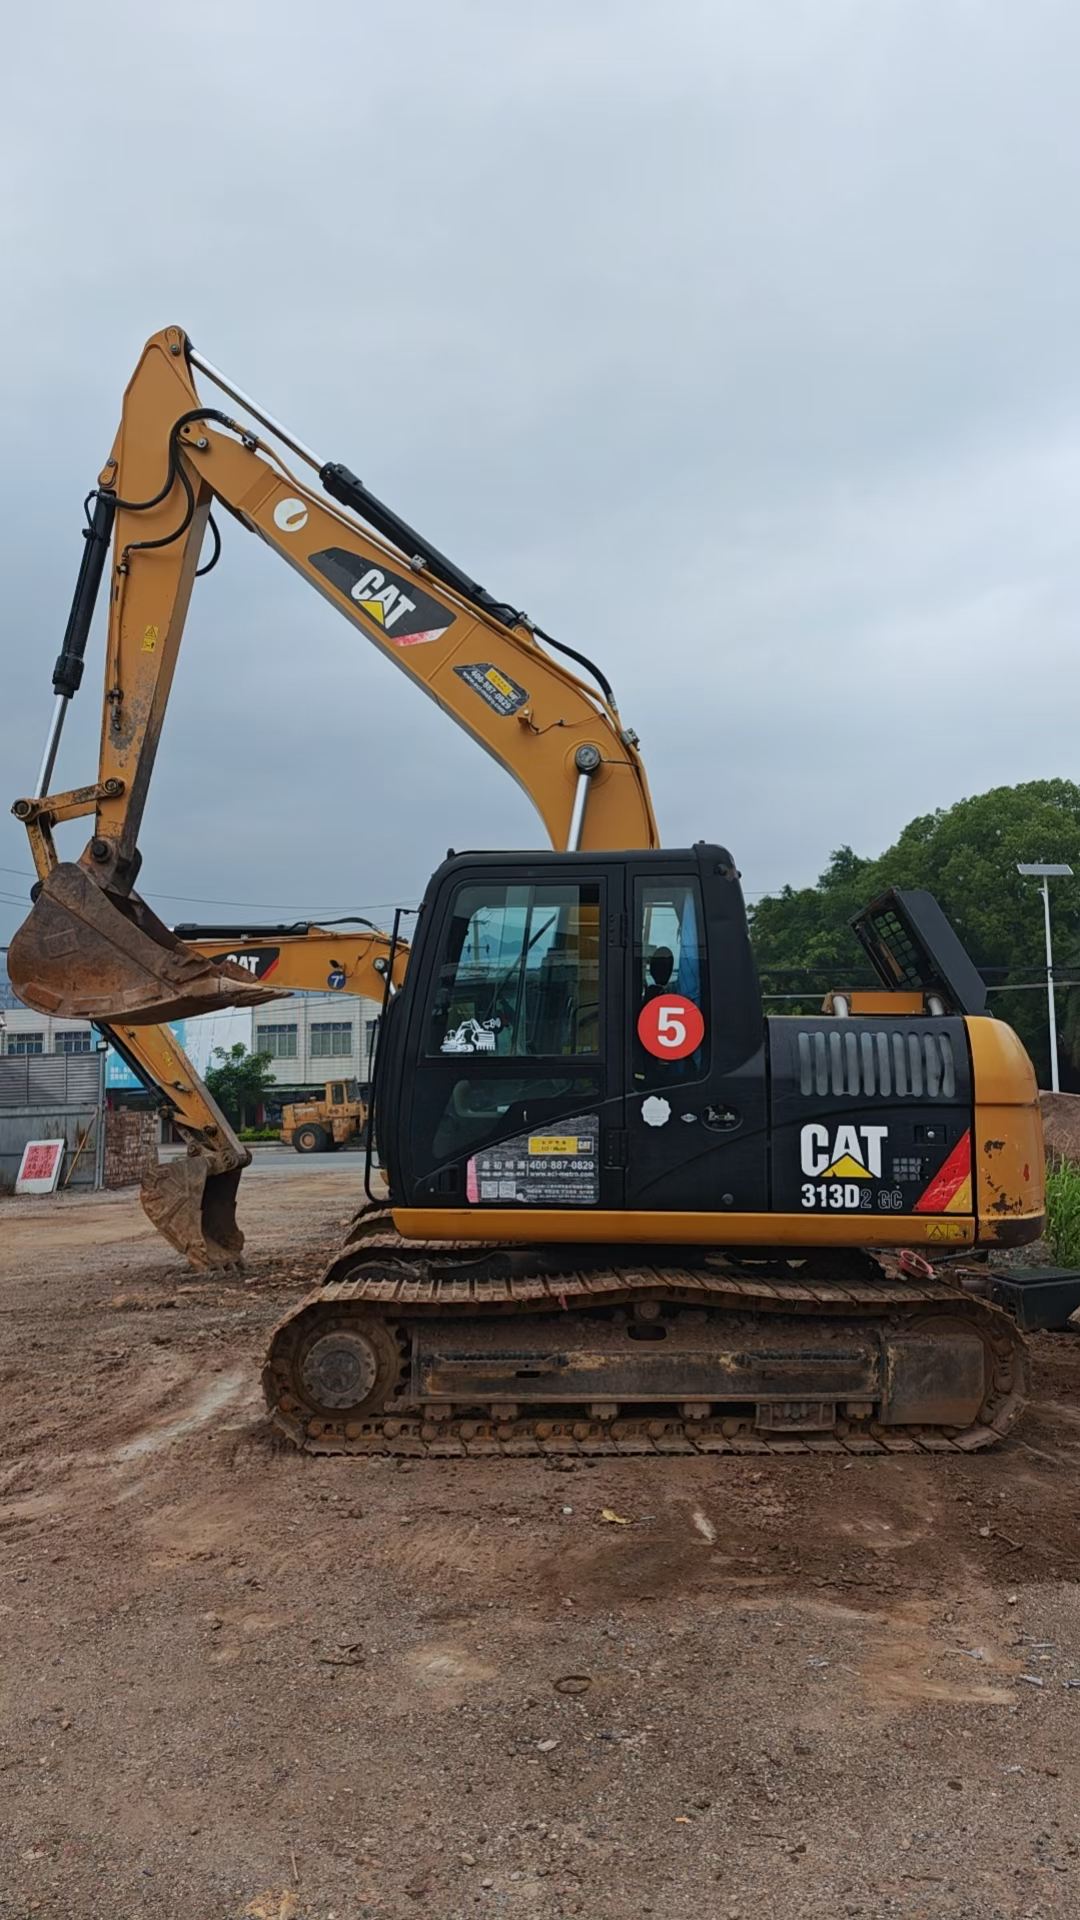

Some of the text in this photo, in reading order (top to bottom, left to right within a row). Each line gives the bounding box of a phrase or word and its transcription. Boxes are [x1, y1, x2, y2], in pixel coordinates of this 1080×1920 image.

[351, 568, 417, 630] CAT
[471, 670, 512, 710] 400-887-0829
[657, 1006, 687, 1048] 5
[529, 1160, 595, 1170] 400-887-0829
[800, 1123, 889, 1179] CAT
[877, 1190, 903, 1210] GC
